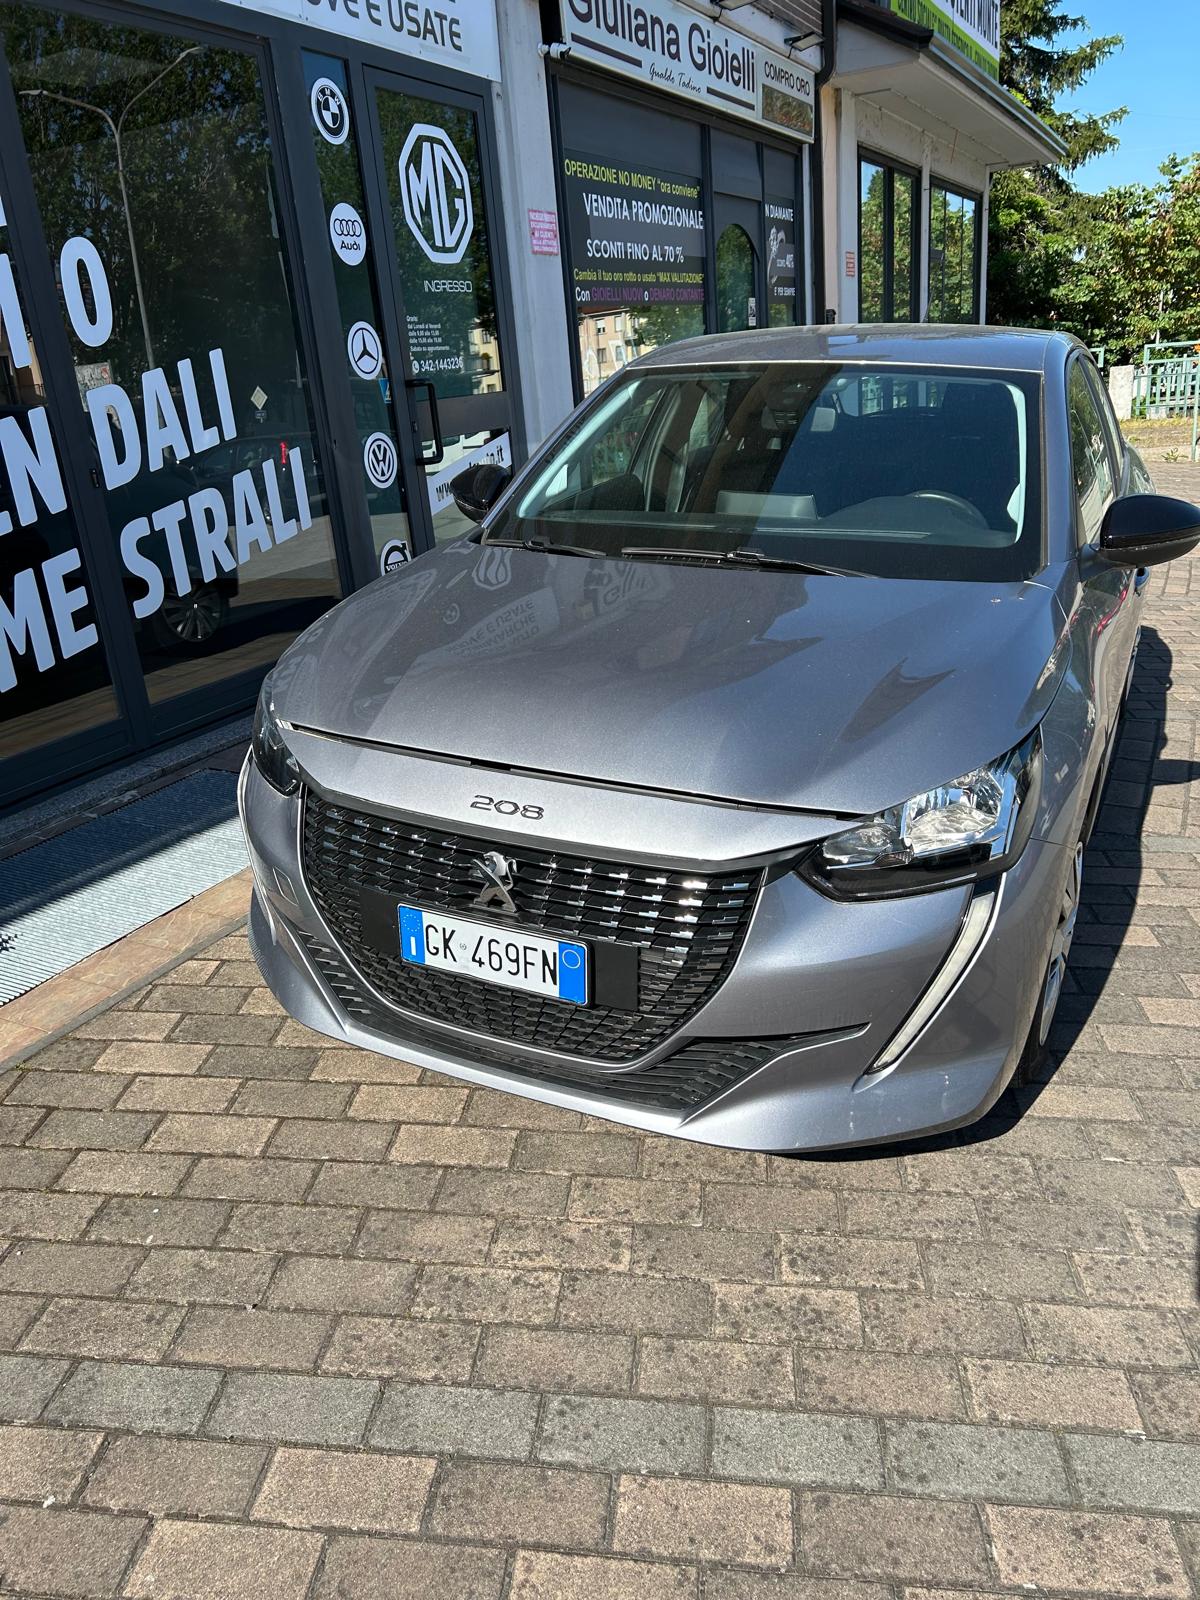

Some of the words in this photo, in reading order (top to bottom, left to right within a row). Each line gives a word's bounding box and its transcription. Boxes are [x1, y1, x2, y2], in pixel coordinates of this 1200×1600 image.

[387, 0, 463, 52] USATE
[688, 22, 756, 94] Gioielli
[649, 63, 676, 85] Gualdo
[678, 72, 702, 94] Tadino
[764, 60, 795, 90] COMPRO
[796, 77, 811, 97] ORO
[564, 158, 618, 184] OPERAZIONE
[618, 170, 631, 187] NO
[631, 172, 656, 191] MONEY
[408, 141, 466, 247] MG
[582, 192, 631, 221] VENDITA
[632, 200, 704, 230] PROMOZIONALE
[769, 204, 794, 222] DIAMANTE
[340, 240, 361, 251] Audi
[586, 238, 625, 259] SCONTI
[627, 242, 650, 261] FINO
[651, 244, 663, 261] AL
[664, 246, 675, 263] 70
[675, 245, 685, 264] %
[60, 236, 113, 348] O
[424, 280, 473, 293] INGRESSO
[573, 268, 597, 281] Cambia
[597, 268, 602, 281] il
[602, 269, 612, 281] tuo
[613, 272, 623, 281] oro
[642, 271, 656, 282] usato
[575, 286, 591, 301] Con
[591, 286, 621, 301] GIOIELLI
[643, 290, 649, 301] o
[649, 287, 675, 301] DENARO
[0, 406, 68, 537] N
[86, 347, 237, 490] DALI
[120, 446, 313, 620] STRALI
[470, 794, 545, 821] 208
[425, 923, 458, 963] GK
[471, 935, 558, 986] 469FN
